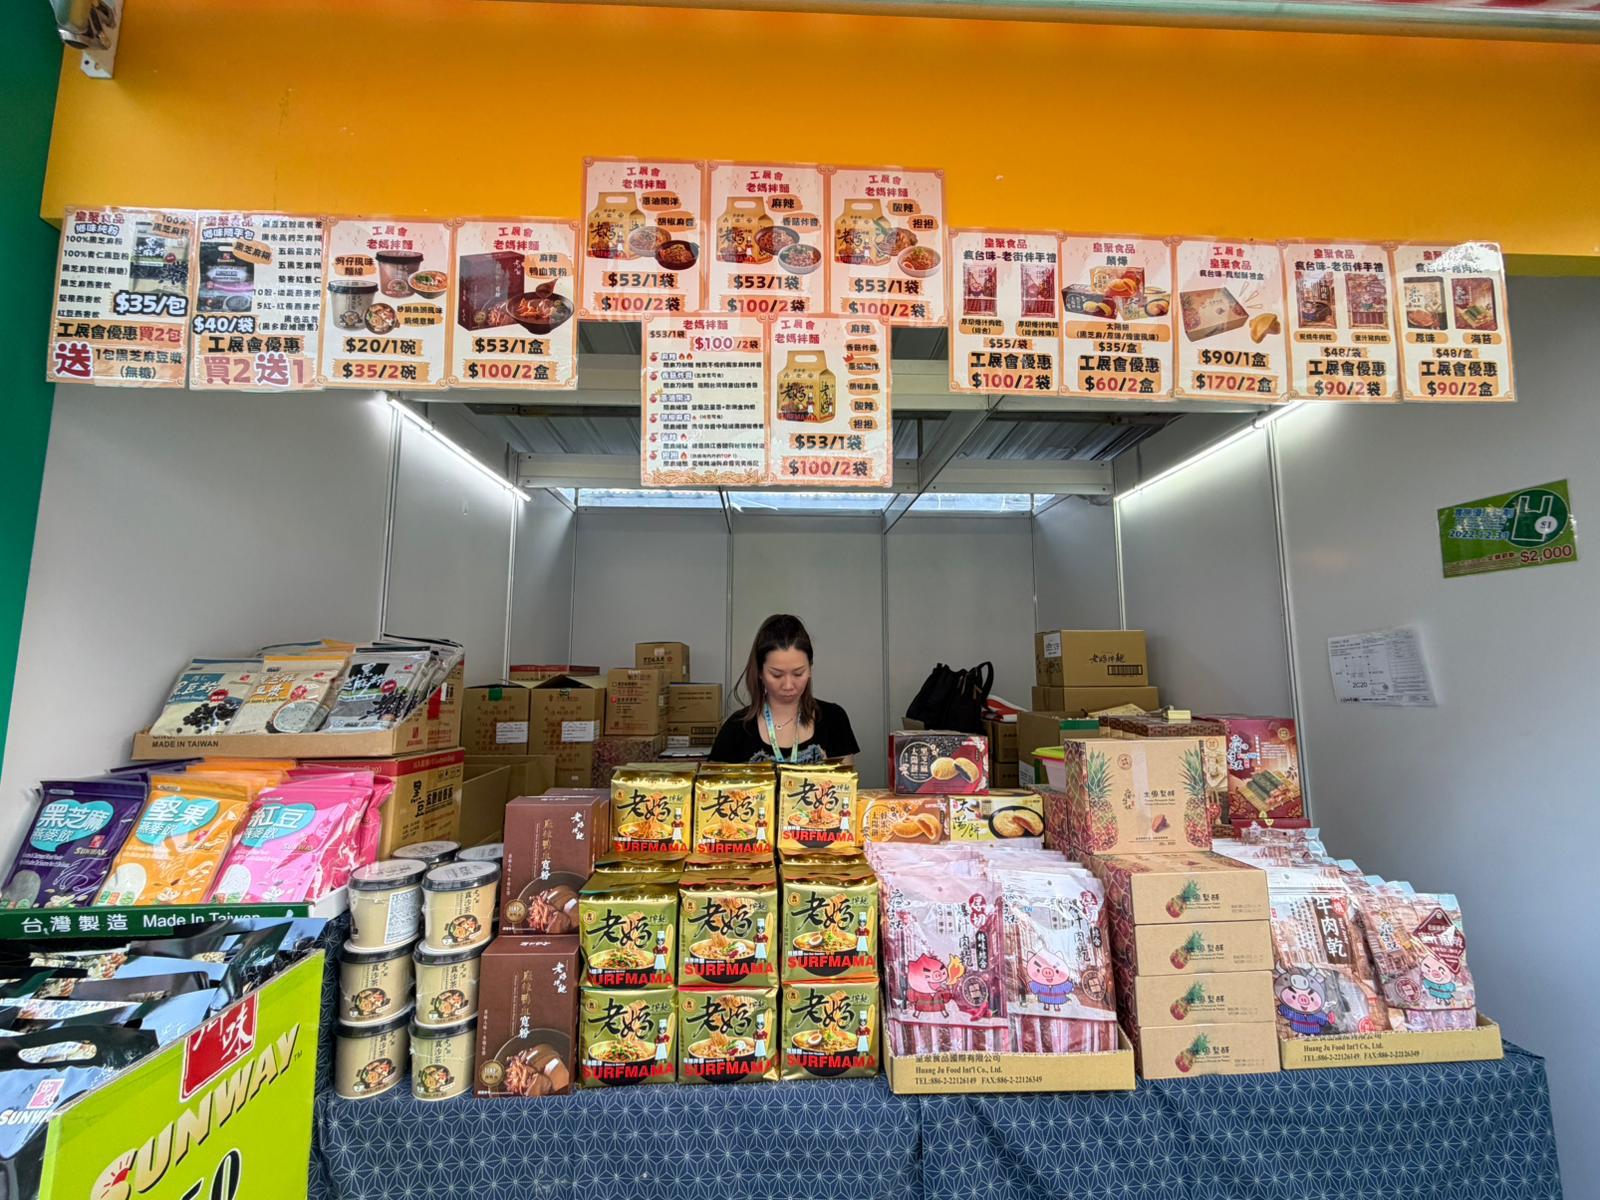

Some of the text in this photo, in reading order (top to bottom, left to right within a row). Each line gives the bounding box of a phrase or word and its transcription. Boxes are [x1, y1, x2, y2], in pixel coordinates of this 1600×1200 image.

[626, 166, 661, 177] 工展會
[750, 170, 783, 181] 工展會
[622, 179, 667, 190] 老媽拌麵
[869, 174, 902, 185] 工展會
[746, 182, 790, 194] 老媽拌麵
[865, 186, 909, 198] 老媽拌麵
[771, 197, 795, 210] 麻辣
[892, 201, 914, 213] 酸辣
[372, 225, 408, 237] 工展會
[498, 226, 534, 238] 工展會
[366, 239, 414, 250] 老媽拌麵
[493, 239, 540, 251] 老媽拌麵
[1213, 246, 1245, 257] 工展會
[539, 253, 558, 263] 麻辣
[608, 272, 675, 288] $53/1袋
[733, 275, 800, 290] $53/1袋
[854, 279, 920, 294] $53/1袋
[115, 292, 188, 316] $35/包
[601, 296, 681, 312] $100/2袋
[727, 298, 806, 313] $100/2袋
[849, 302, 926, 317] $100/2袋
[193, 316, 255, 333] $40/袋
[683, 319, 728, 330] 老媽拌麵
[781, 320, 815, 331] 工展會
[850, 325, 870, 334] 麻辣
[649, 330, 686, 339] $53/1袋
[775, 333, 820, 345] 老媽拌麵
[1471, 334, 1492, 344] 海苔
[207, 336, 300, 354] 工展會優惠
[345, 338, 417, 355] $20/1碗
[474, 338, 544, 355] $53/1盒
[695, 337, 759, 350] $100 /2袋
[988, 339, 1028, 350] $55/袋
[1098, 342, 1137, 353] $35/盒
[55, 343, 92, 377] 送
[970, 352, 1052, 371] 工展會優惠
[1079, 355, 1160, 373] 工展會優惠
[1201, 349, 1266, 367] $90/1盒
[120, 366, 157, 379] (無糖)
[204, 354, 305, 386] 買2送1
[342, 364, 417, 381] $35/2碗
[468, 363, 550, 380] $100/2盒
[1308, 360, 1386, 377] 工展會優惠
[1420, 360, 1498, 377] 工展會優惠
[972, 372, 1051, 390] $100/2袋
[1085, 376, 1154, 394] $60/2盒
[1196, 373, 1272, 392] $170/2盒
[1314, 381, 1381, 397] $90/2袋
[1427, 381, 1493, 397] $90/2盒
[854, 402, 874, 411] 酸辣
[795, 434, 862, 450] $53/1袋
[789, 459, 868, 477] $100/2袋
[1520, 545, 1572, 562] $2,000
[38, 803, 108, 831] 黑芝麻
[144, 800, 208, 826] 堅果
[248, 806, 308, 829] 紅豆
[782, 829, 855, 842] SURFMAMA
[614, 842, 688, 853] SURFMAMA
[697, 842, 773, 854] SURFMAMA
[20, 914, 129, 934] 台灣製造
[143, 914, 186, 928] Made
[191, 913, 205, 924] In
[1316, 895, 1348, 958] 牛肉乾
[684, 962, 774, 977] SURFMAMA
[787, 955, 875, 969] SURFMAMA
[684, 1055, 778, 1077] SURFMAMA
[787, 1055, 876, 1068] SURFMAMA
[582, 1062, 675, 1080] SURFMAMA
[990, 1066, 1003, 1074] Ltd.
